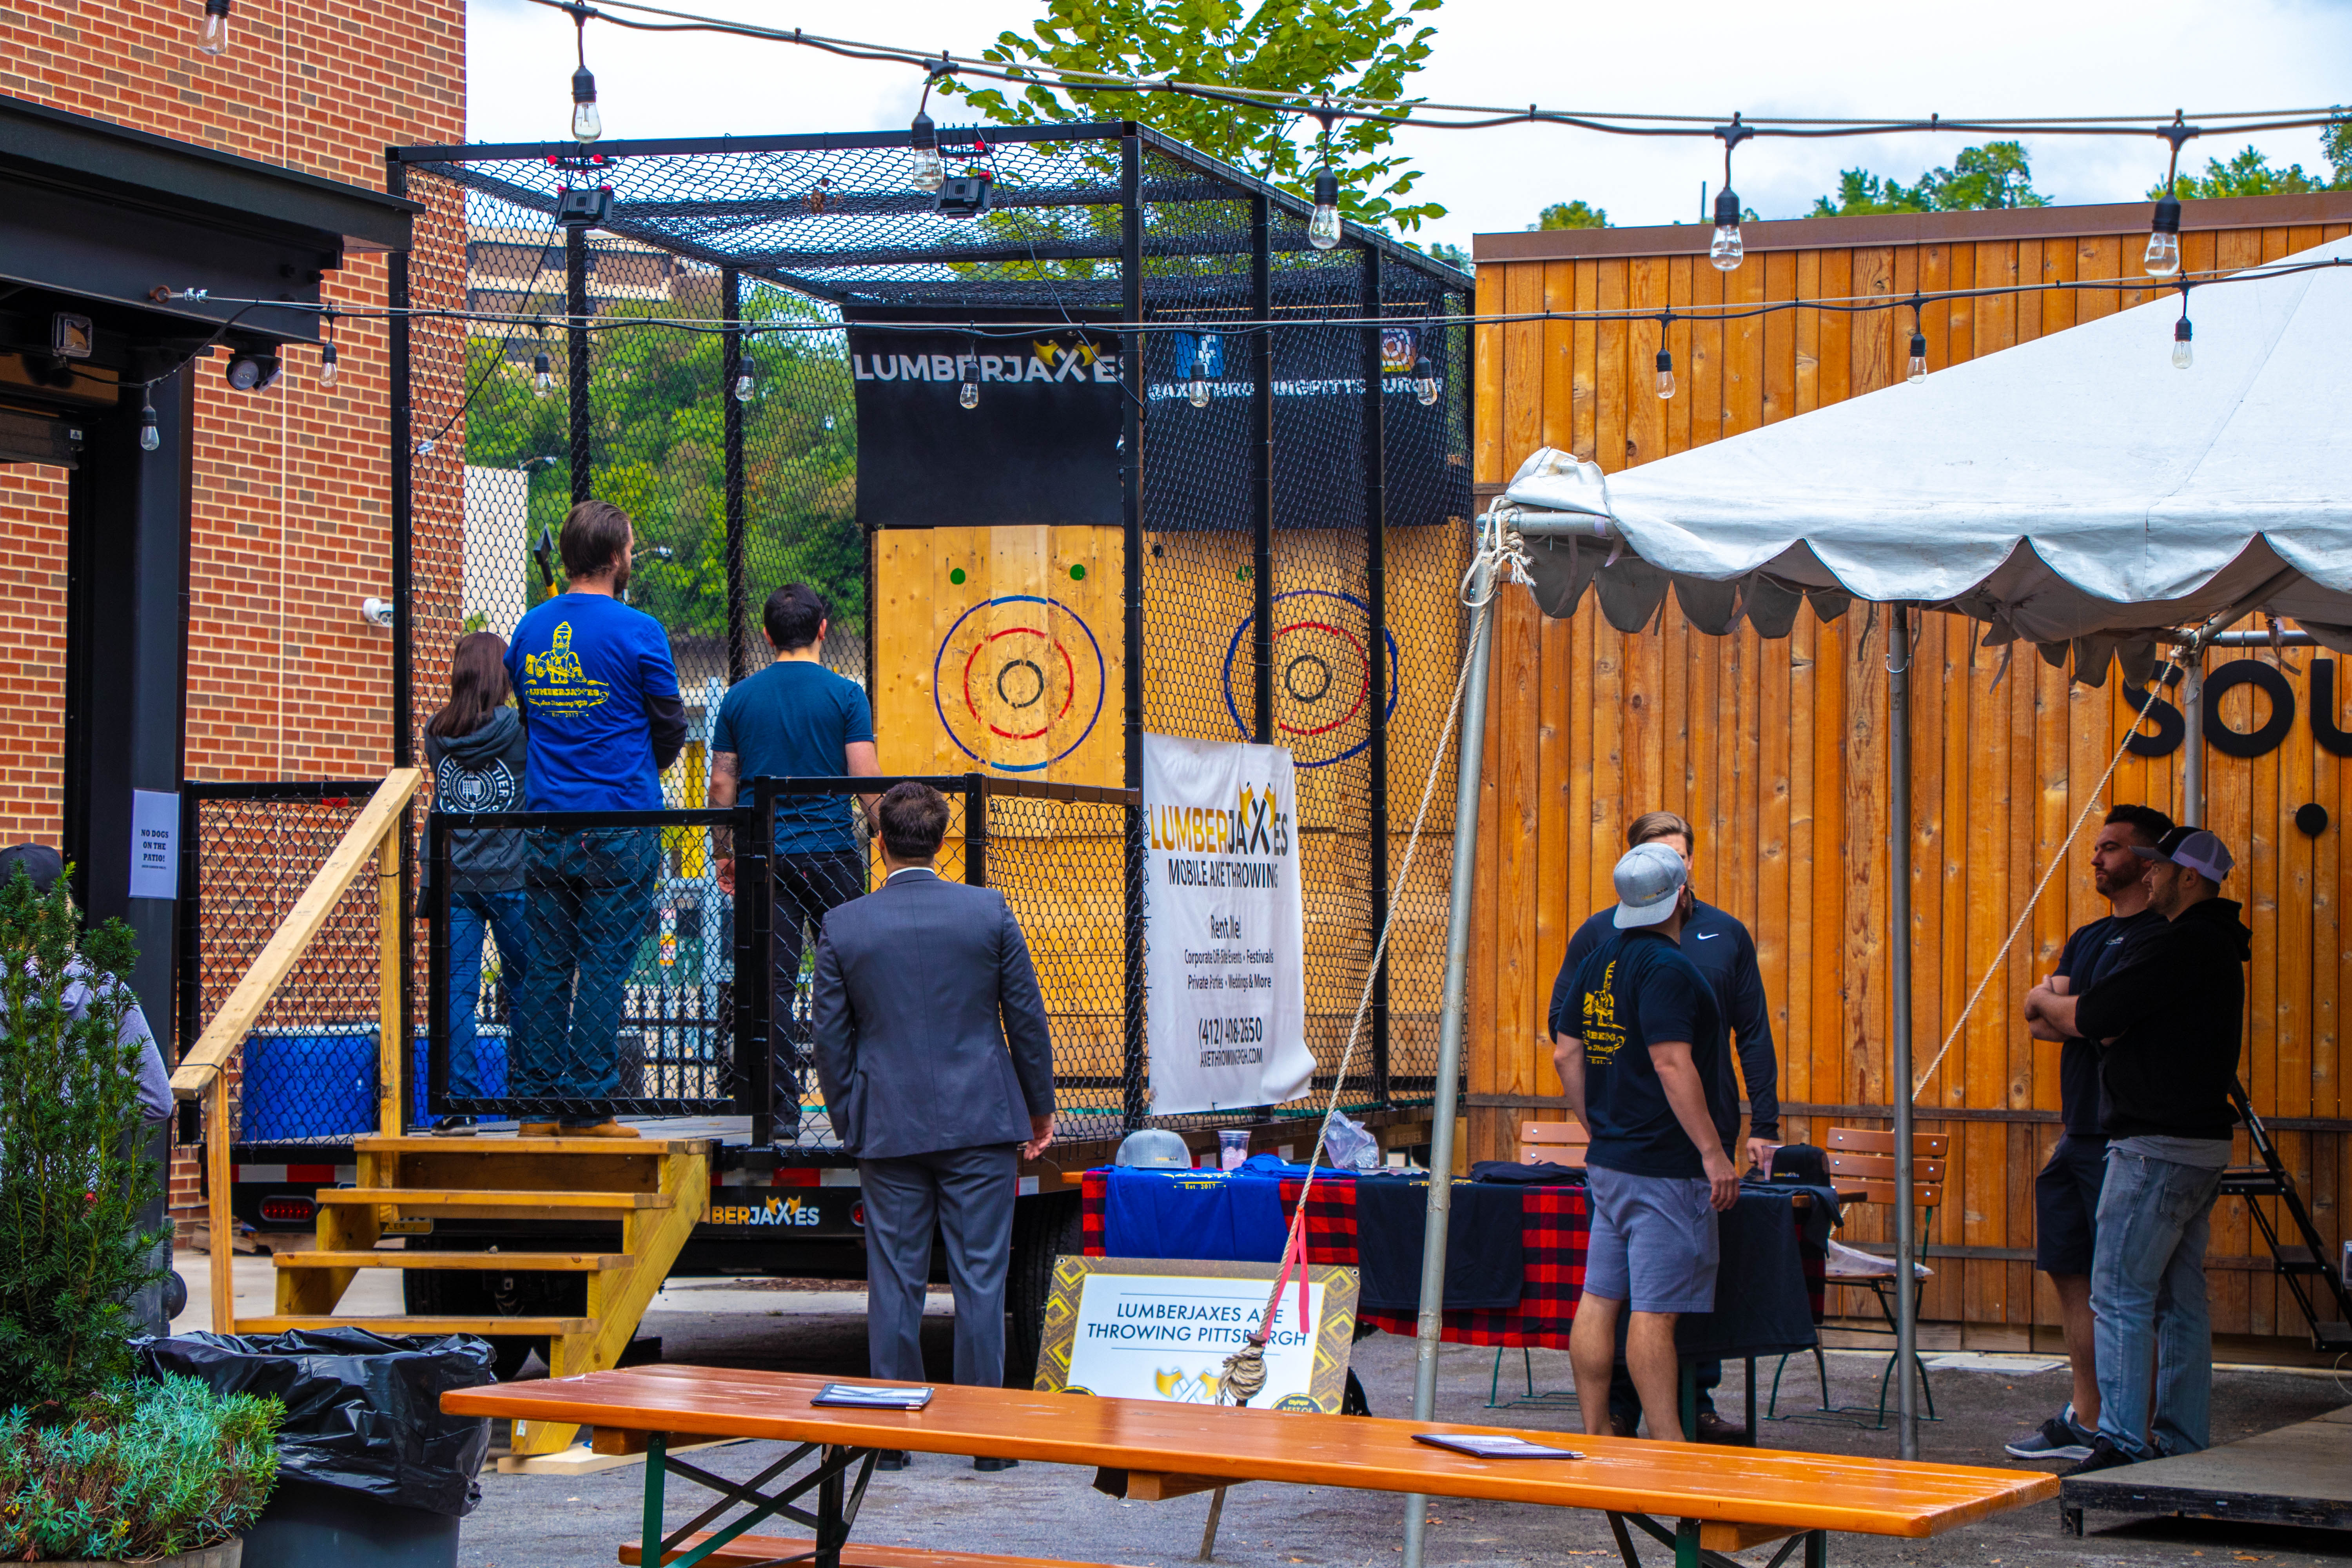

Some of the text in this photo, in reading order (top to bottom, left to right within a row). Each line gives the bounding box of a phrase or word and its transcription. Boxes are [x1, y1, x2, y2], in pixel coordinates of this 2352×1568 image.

[853, 339, 1124, 383] LUMBERJAXE
[530, 688, 599, 696] LUMBERJAXES
[492, 766, 509, 798] TIER
[1149, 782, 1288, 856] LUMBERJAXES
[143, 853, 165, 862] PATIO!
[1168, 858, 1278, 888] MOBILE AXE THROWING
[1210, 915, 1241, 940] Rent Me!
[1185, 948, 1274, 968] Corporate Off-Site Events Festivals
[1188, 974, 1271, 992] Private Parties Weddings & More
[1198, 1016, 1263, 1049] (412) 408-2650
[1200, 1048, 1263, 1067] AXETHROWINGPGH.COM
[712, 1196, 820, 1225] BERJAXES
[1117, 1303, 1284, 1323] LUMBERJAXES AE
[1087, 1323, 1307, 1346] THROWING PITTSBRGH
